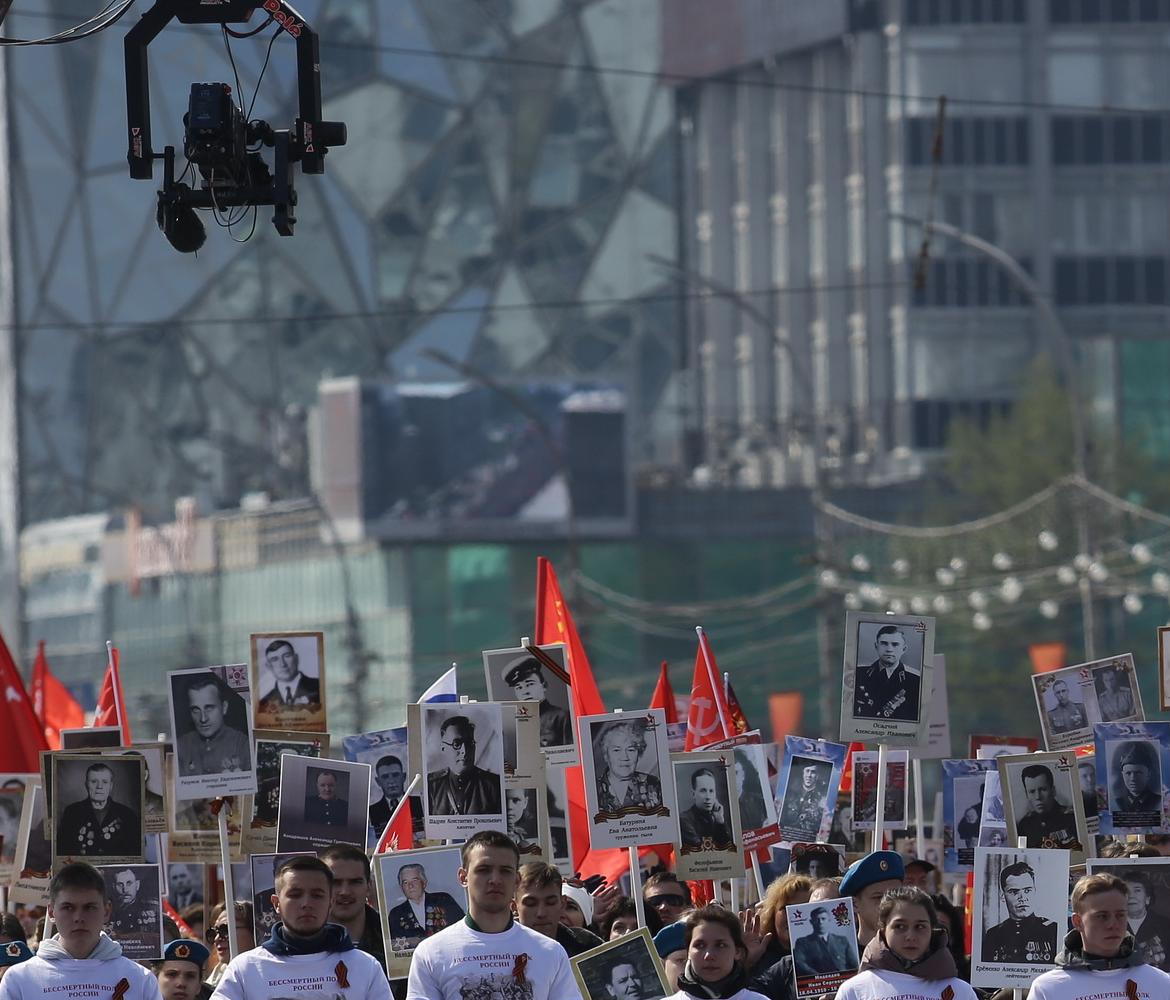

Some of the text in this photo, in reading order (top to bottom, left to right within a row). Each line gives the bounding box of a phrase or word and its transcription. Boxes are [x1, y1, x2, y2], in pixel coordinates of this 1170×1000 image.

[268, 976, 325, 987] БЕССМЕРТНЫЙ
[293, 983, 324, 991] РОССИИ
[43, 983, 100, 994] БЕССМЕРТНЫЙ
